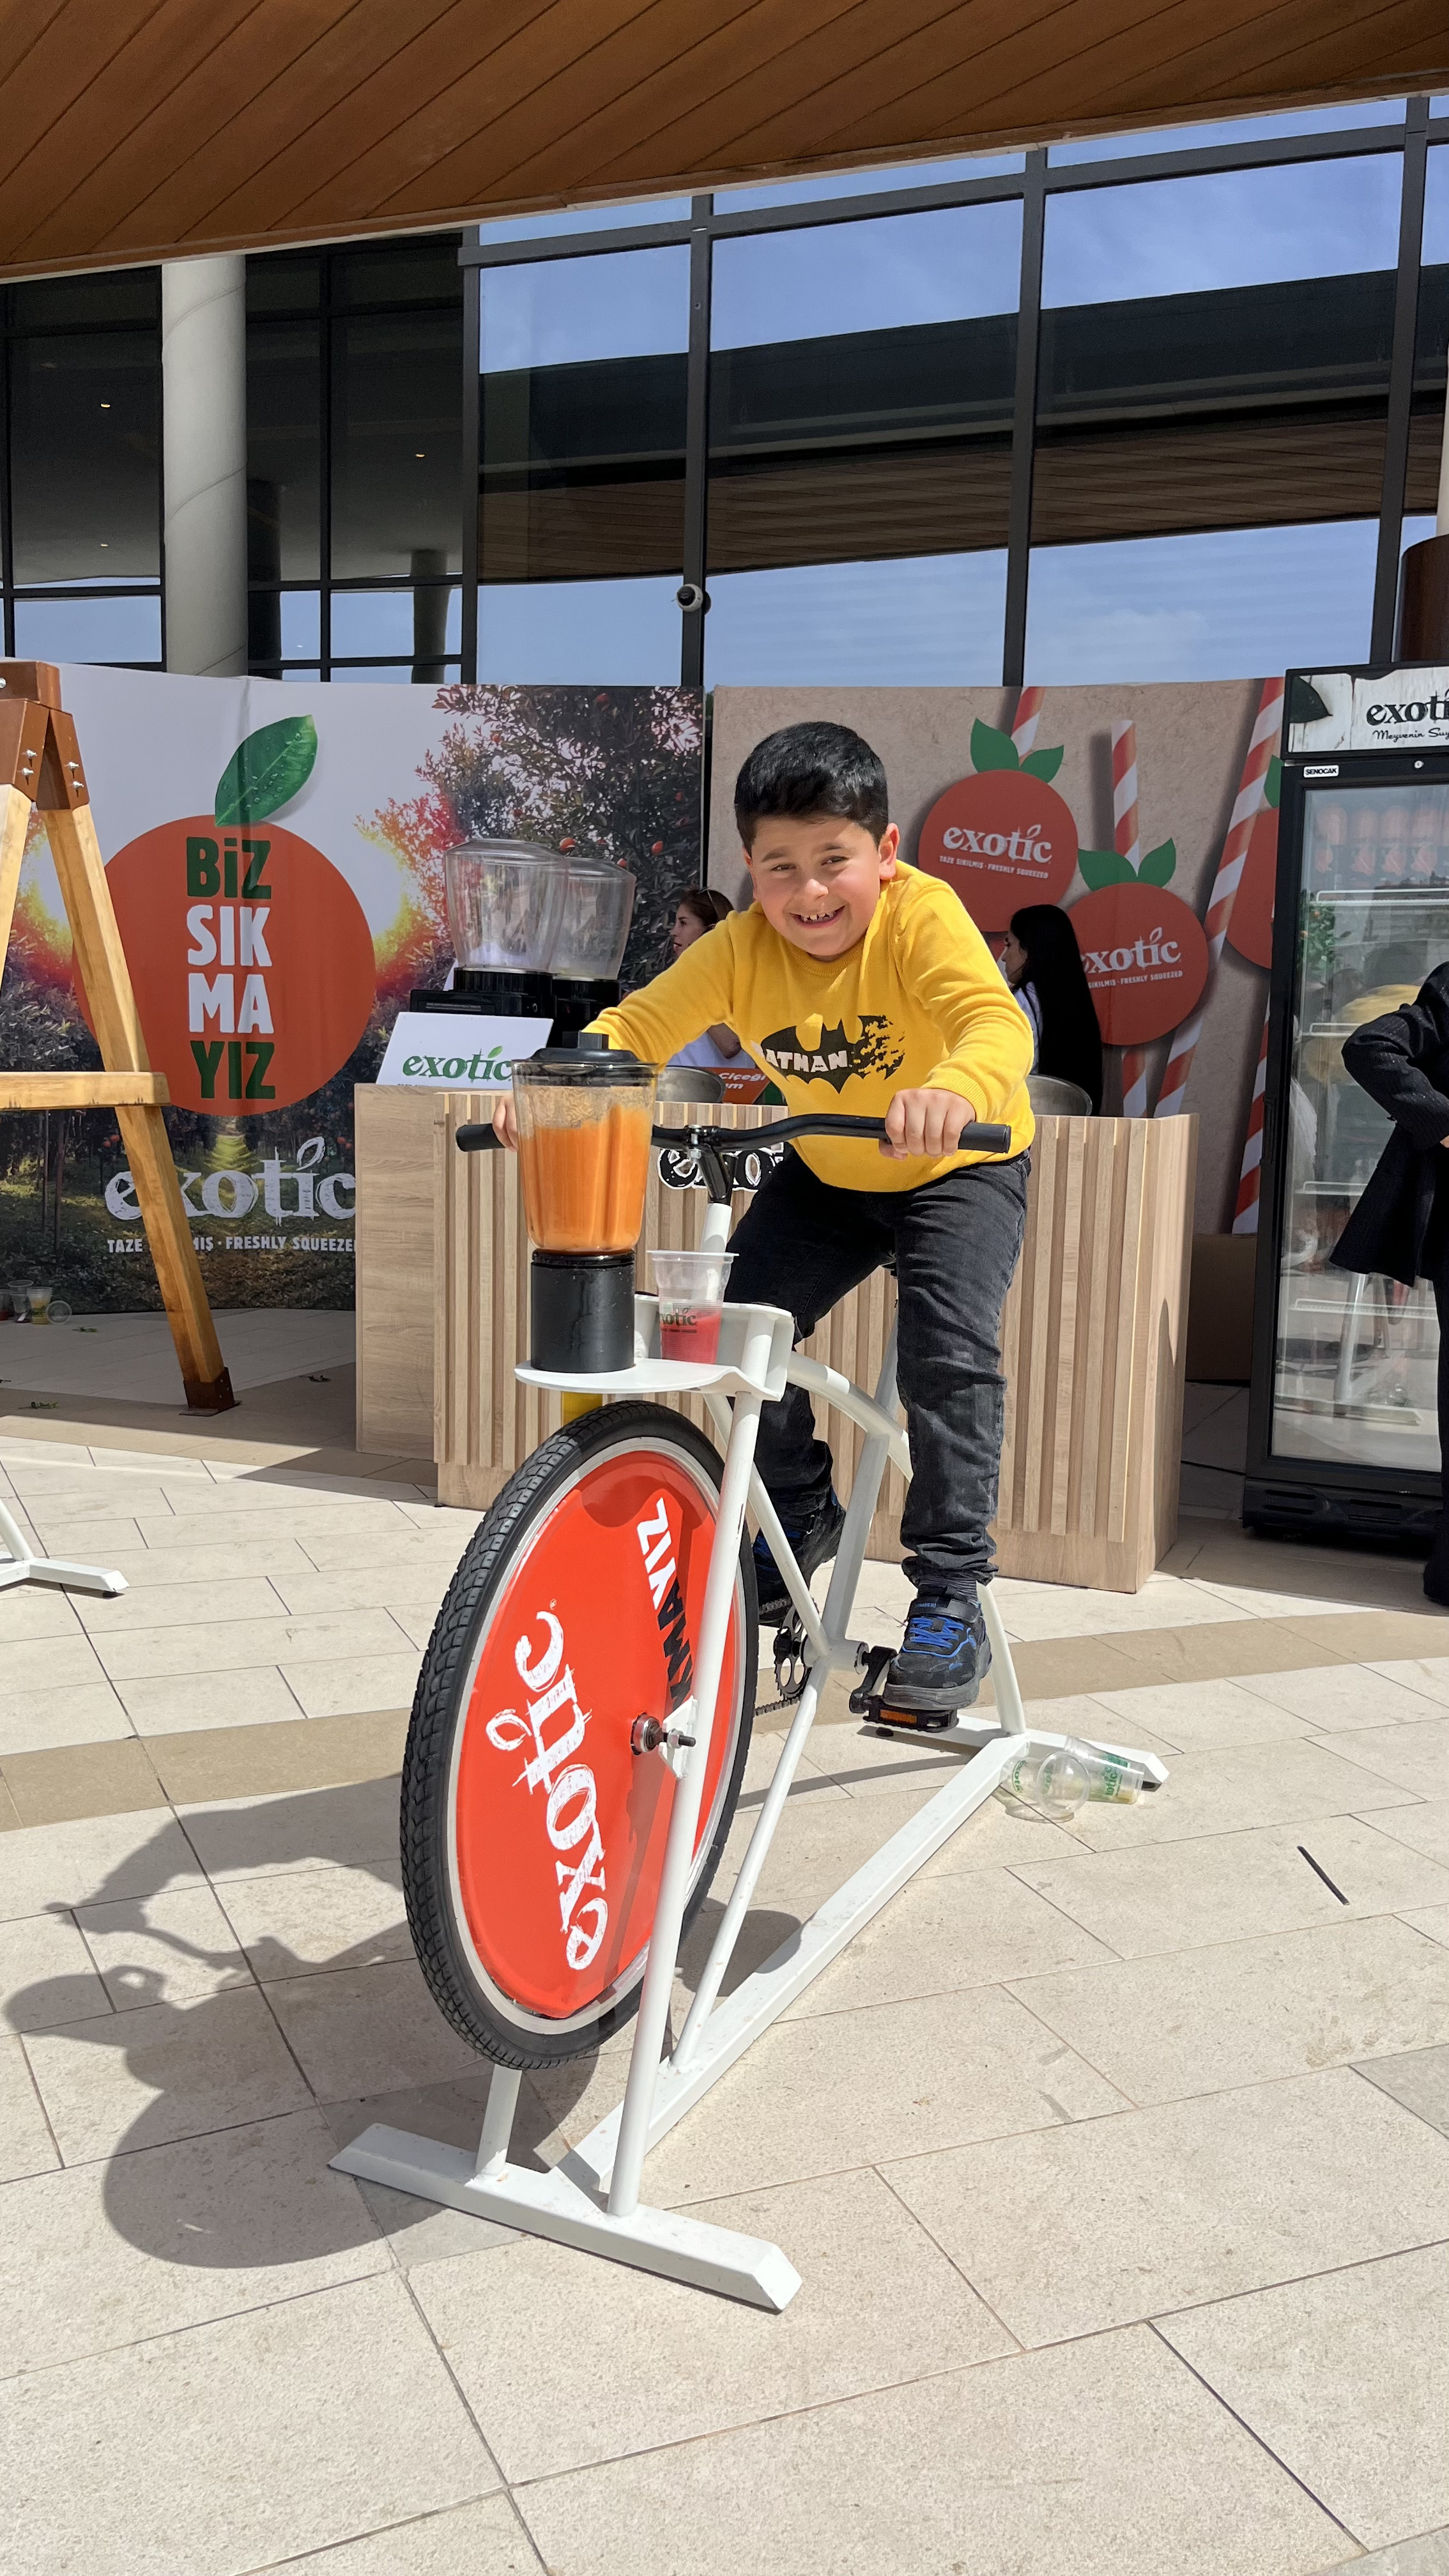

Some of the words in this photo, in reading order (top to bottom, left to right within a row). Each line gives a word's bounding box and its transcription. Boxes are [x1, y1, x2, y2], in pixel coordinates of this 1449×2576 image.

[1372, 730, 1425, 742] Meyvenin
[943, 824, 1053, 863] exotic
[988, 863, 1015, 873] FRESHLY
[1016, 868, 1049, 878] SQUEEZED
[187, 905, 273, 967] SIK
[1120, 975, 1148, 985] FRESHLY
[1150, 970, 1183, 981] SQUEEZED
[188, 973, 275, 1034] MA
[190, 1040, 276, 1099] YIZ
[402, 1046, 512, 1083] exotic
[107, 1238, 143, 1253] TAZE
[226, 1236, 288, 1250] FRESHLY
[292, 1237, 356, 1253] SQUEEZE
[486, 1610, 609, 1970] exotic
